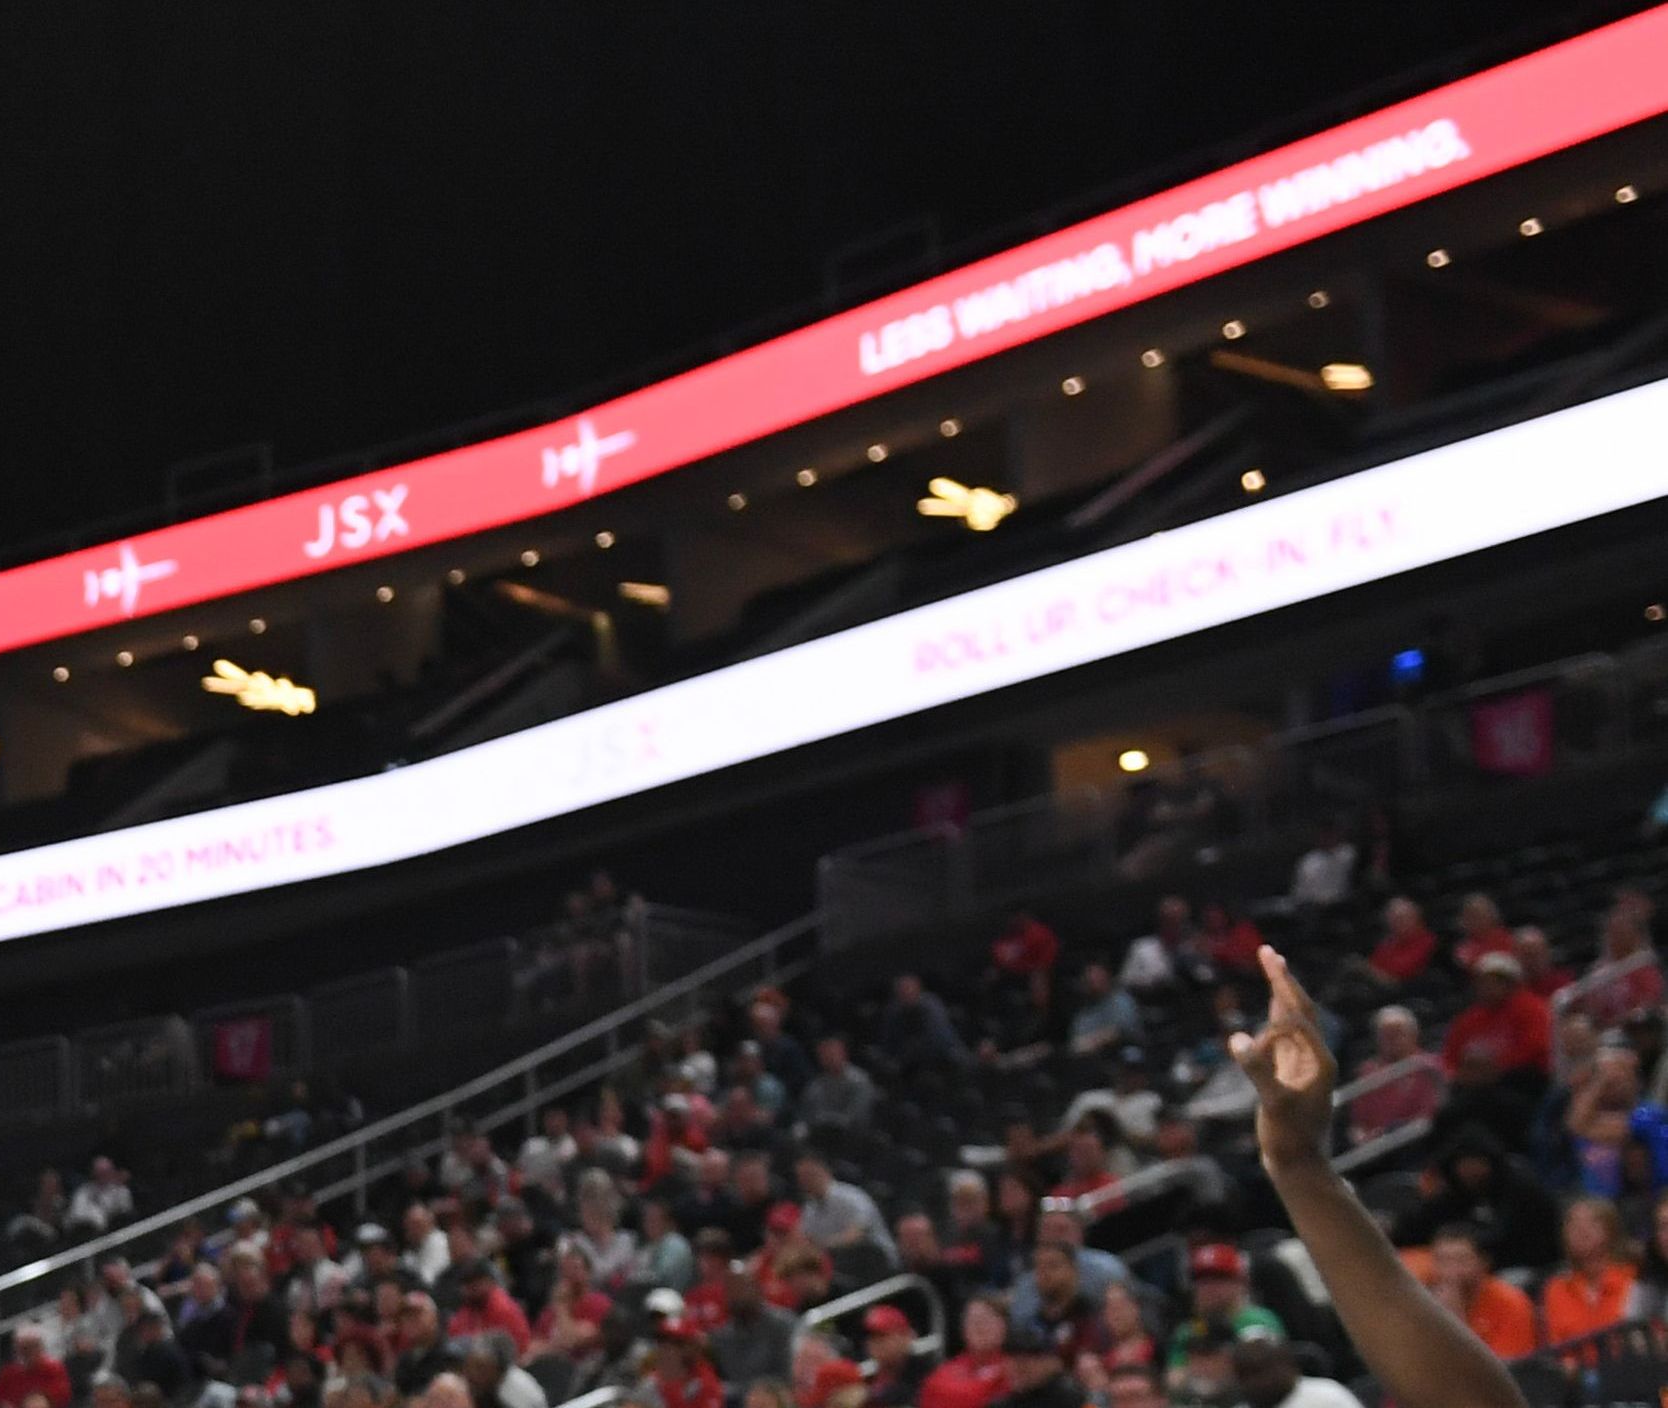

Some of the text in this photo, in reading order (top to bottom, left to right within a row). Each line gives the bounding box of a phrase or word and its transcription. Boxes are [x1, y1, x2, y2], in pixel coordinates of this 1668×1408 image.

[861, 306, 953, 373] LESS
[1133, 192, 1255, 272] MORE
[303, 484, 410, 560] JSX
[96, 862, 126, 891] IN
[137, 850, 174, 885] 20
